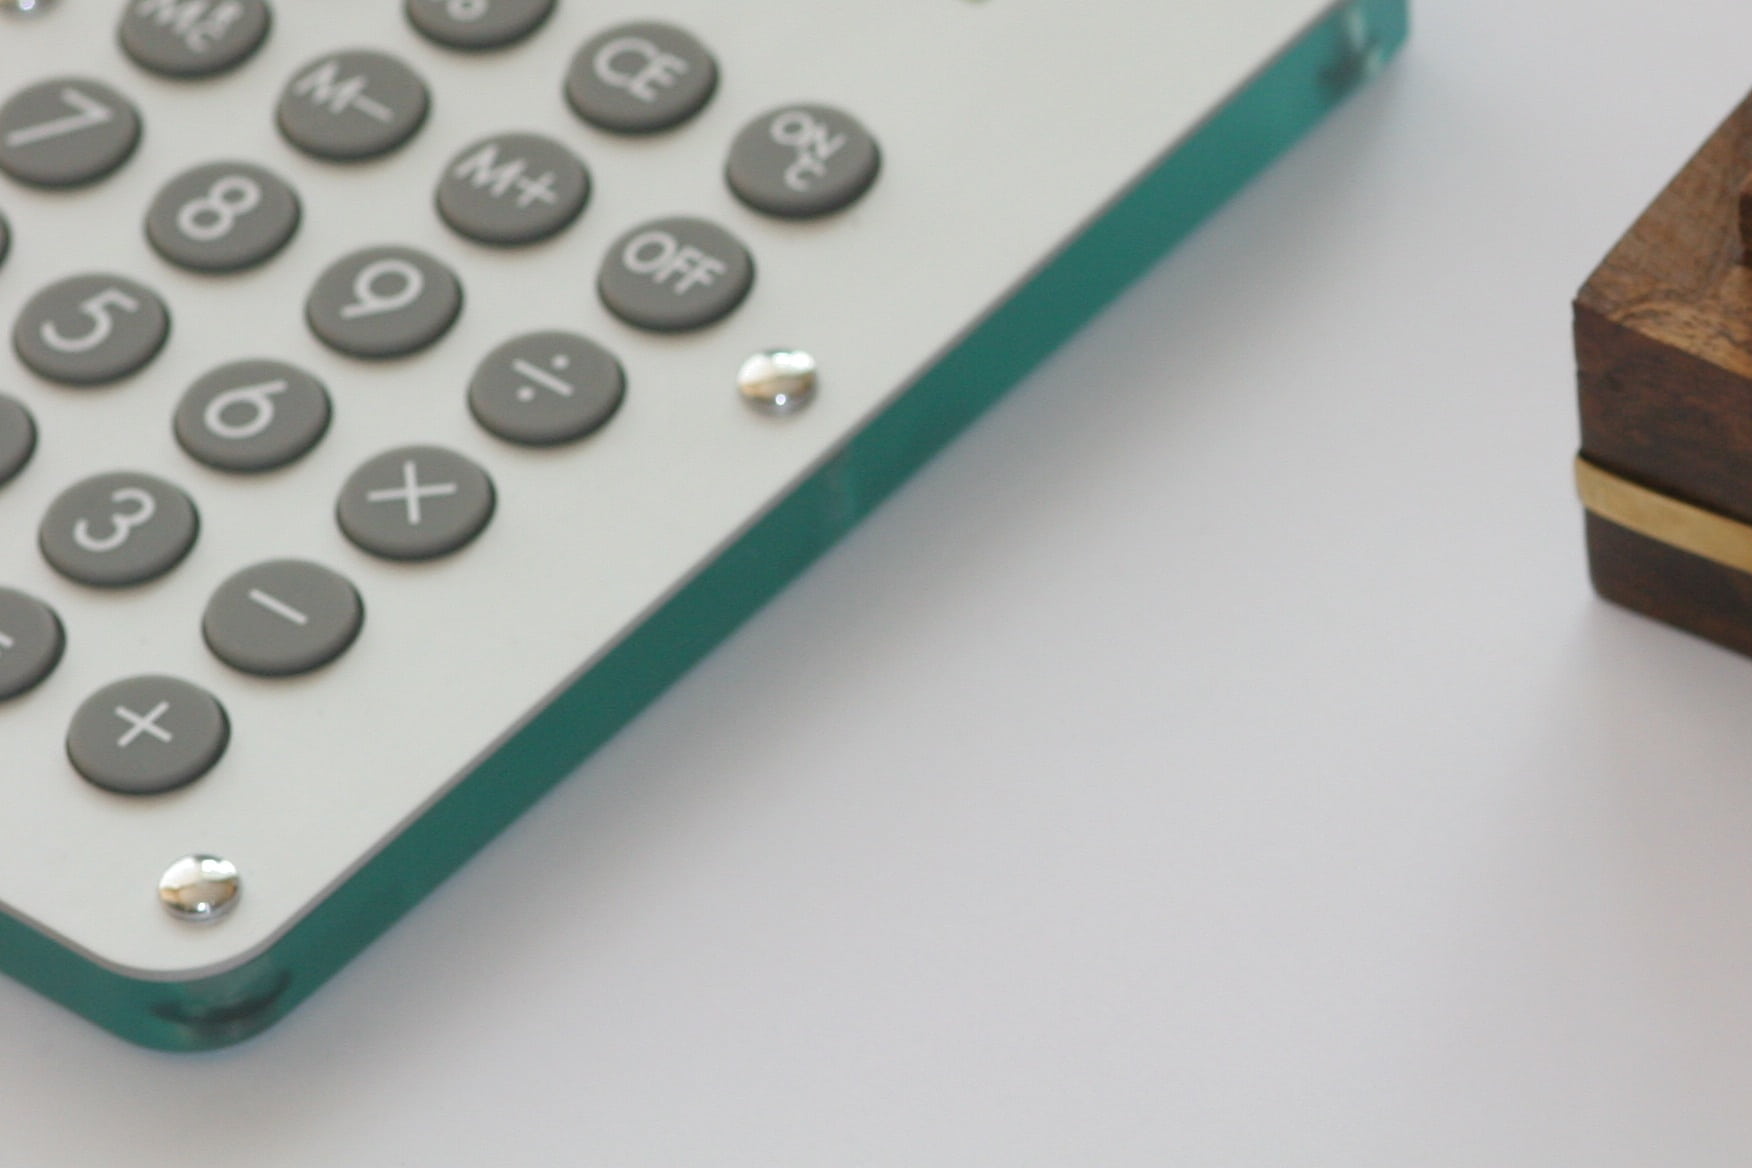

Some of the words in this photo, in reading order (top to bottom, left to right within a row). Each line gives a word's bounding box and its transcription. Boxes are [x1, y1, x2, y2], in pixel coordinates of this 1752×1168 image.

[592, 36, 689, 102] CE
[3, 86, 113, 148] 7
[768, 110, 848, 160] ON
[176, 174, 262, 240] 8
[454, 143, 557, 208] M+
[340, 259, 424, 319] 9
[621, 230, 727, 295] OFF
[40, 288, 139, 352] 5
[204, 379, 288, 439] 6
[73, 487, 156, 551] 3
